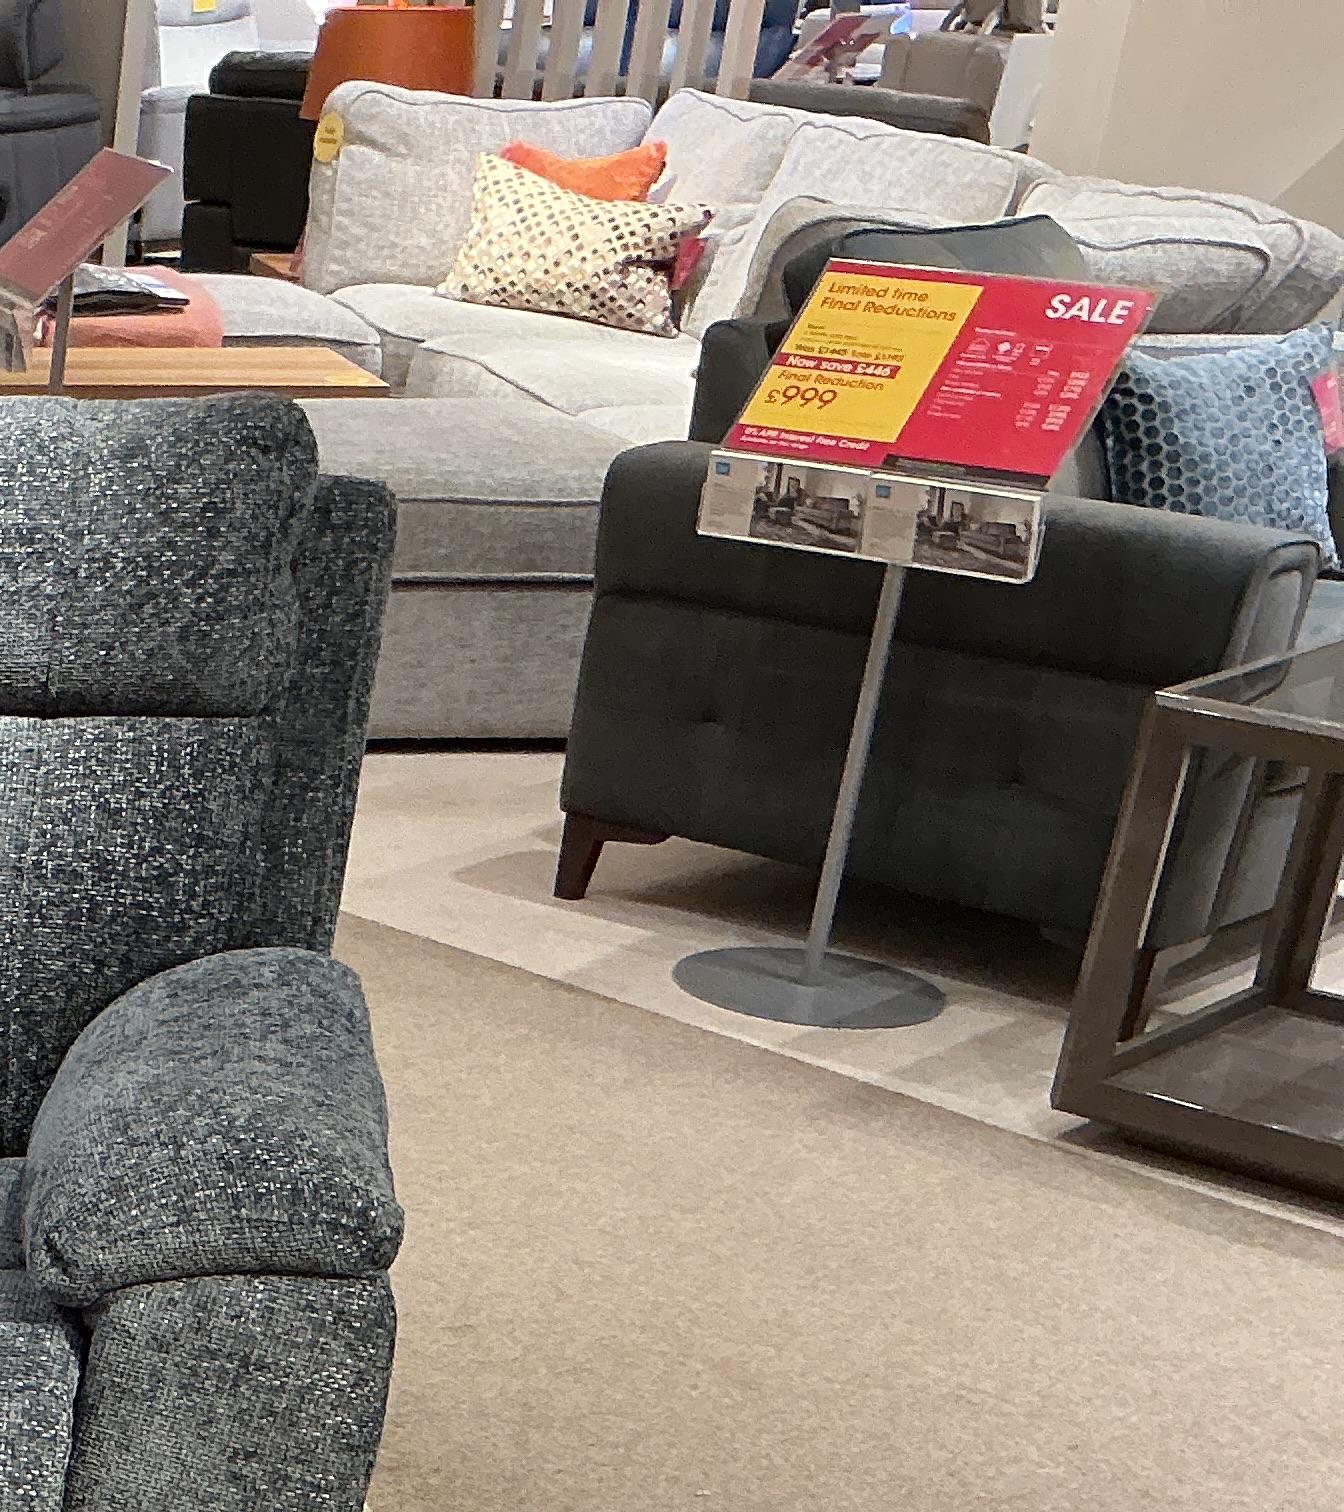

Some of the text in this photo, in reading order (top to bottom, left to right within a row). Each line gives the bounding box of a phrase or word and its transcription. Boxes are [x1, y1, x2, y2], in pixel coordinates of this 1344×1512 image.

[827, 281, 930, 303] Limited time
[820, 296, 958, 323] Final Reductions
[1044, 292, 1135, 326] SALE
[785, 355, 818, 369] Now
[819, 360, 853, 373] save
[777, 369, 885, 392] Final Reduction
[764, 384, 839, 410] £999
[838, 439, 872, 451] Credit
